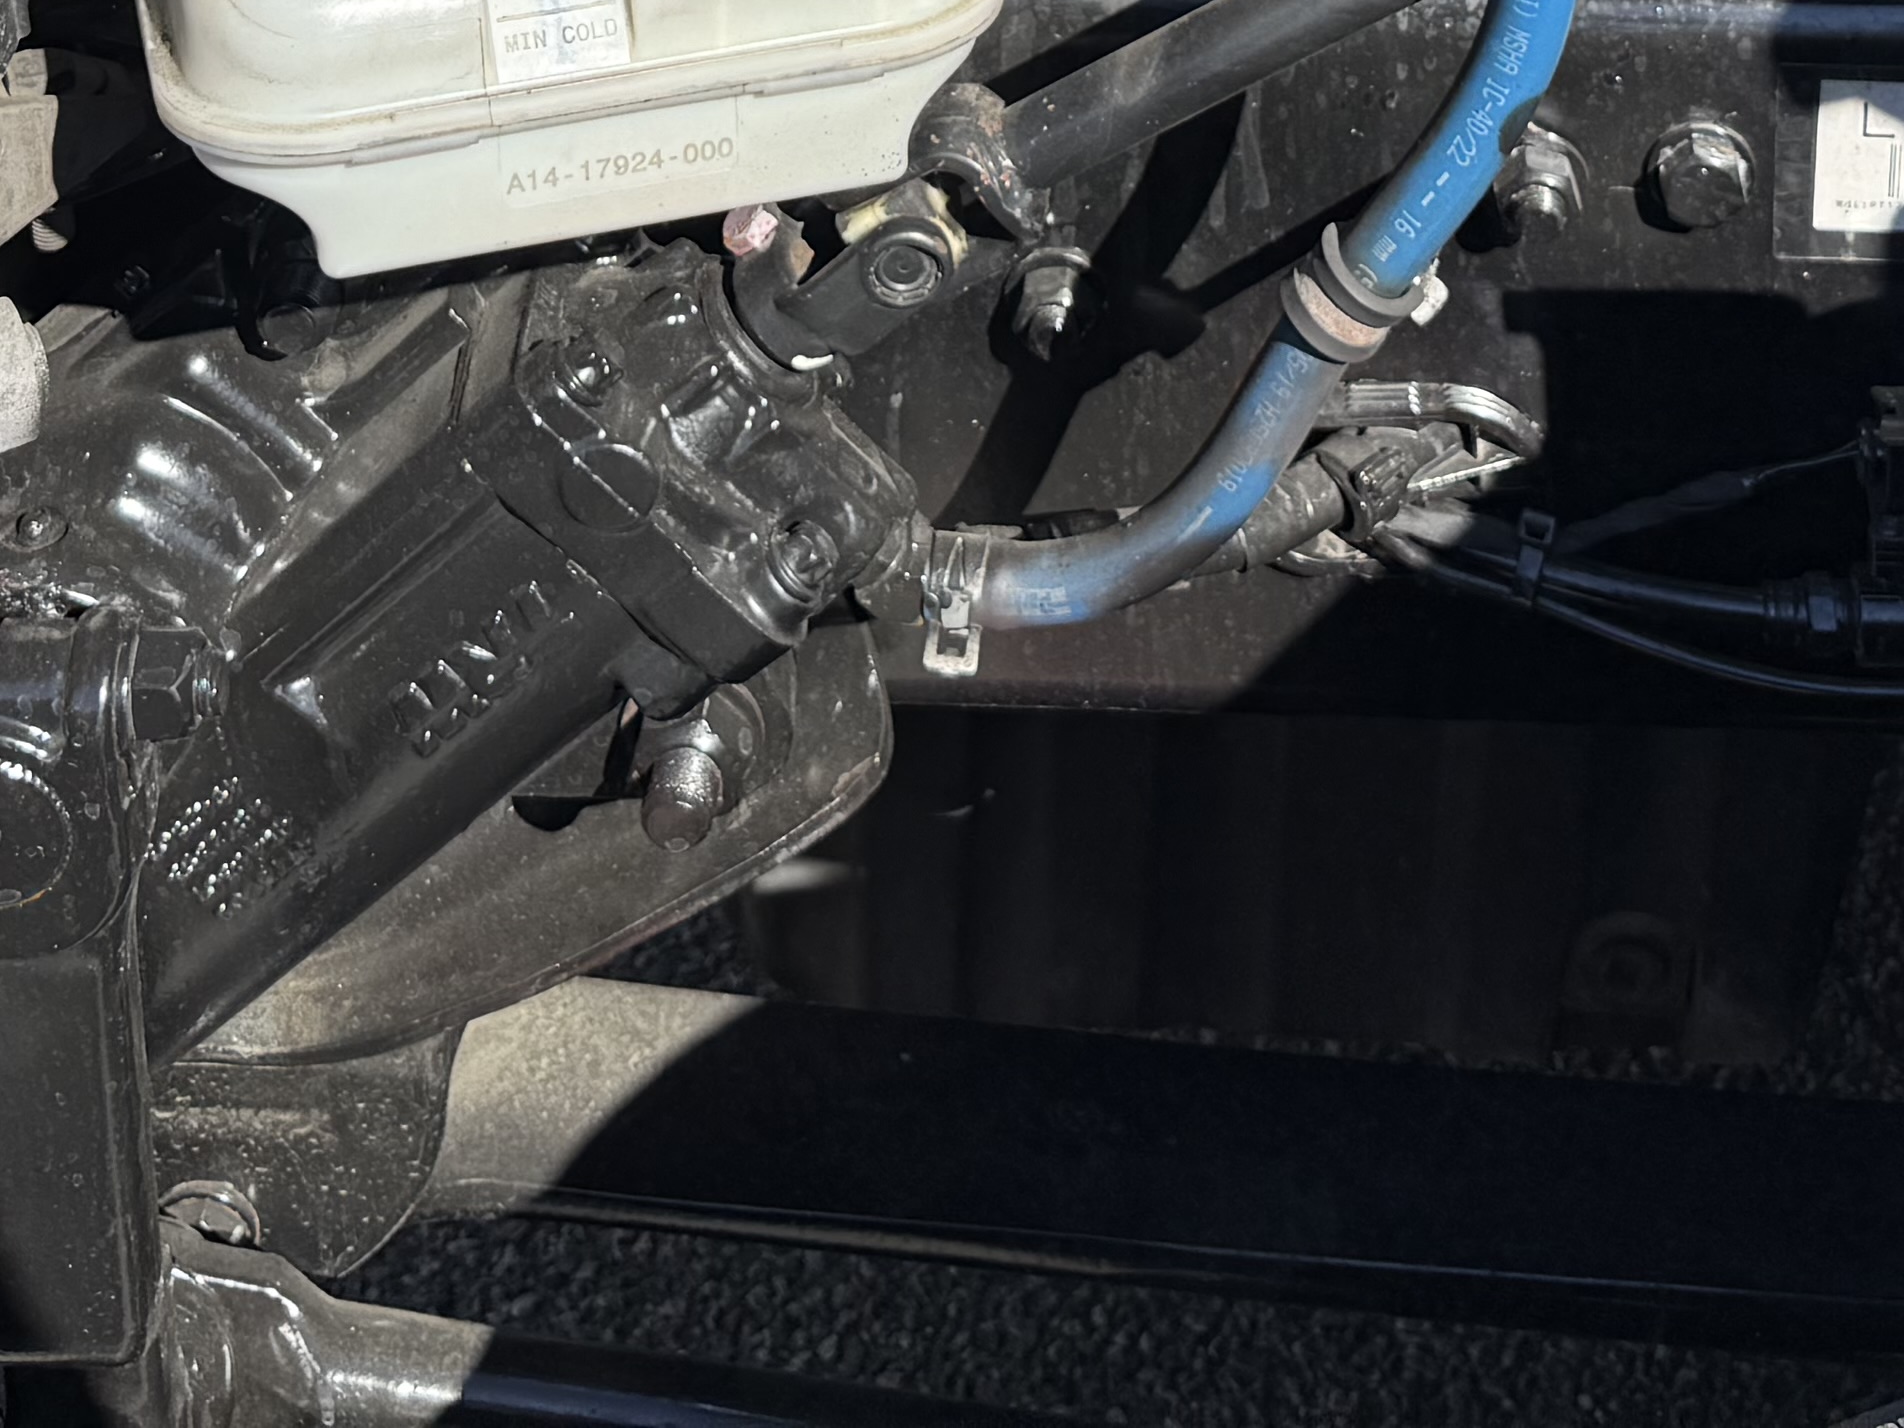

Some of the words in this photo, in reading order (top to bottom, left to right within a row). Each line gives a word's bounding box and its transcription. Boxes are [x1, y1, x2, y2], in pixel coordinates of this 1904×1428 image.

[504, 29, 550, 54] MIN
[561, 15, 620, 43] COLD
[1493, 25, 1532, 78] MSHA
[1446, 77, 1512, 168] IC-40/22
[506, 136, 736, 197] A14-17924-000
[1393, 208, 1422, 239] 16
[1373, 233, 1399, 263] mm
